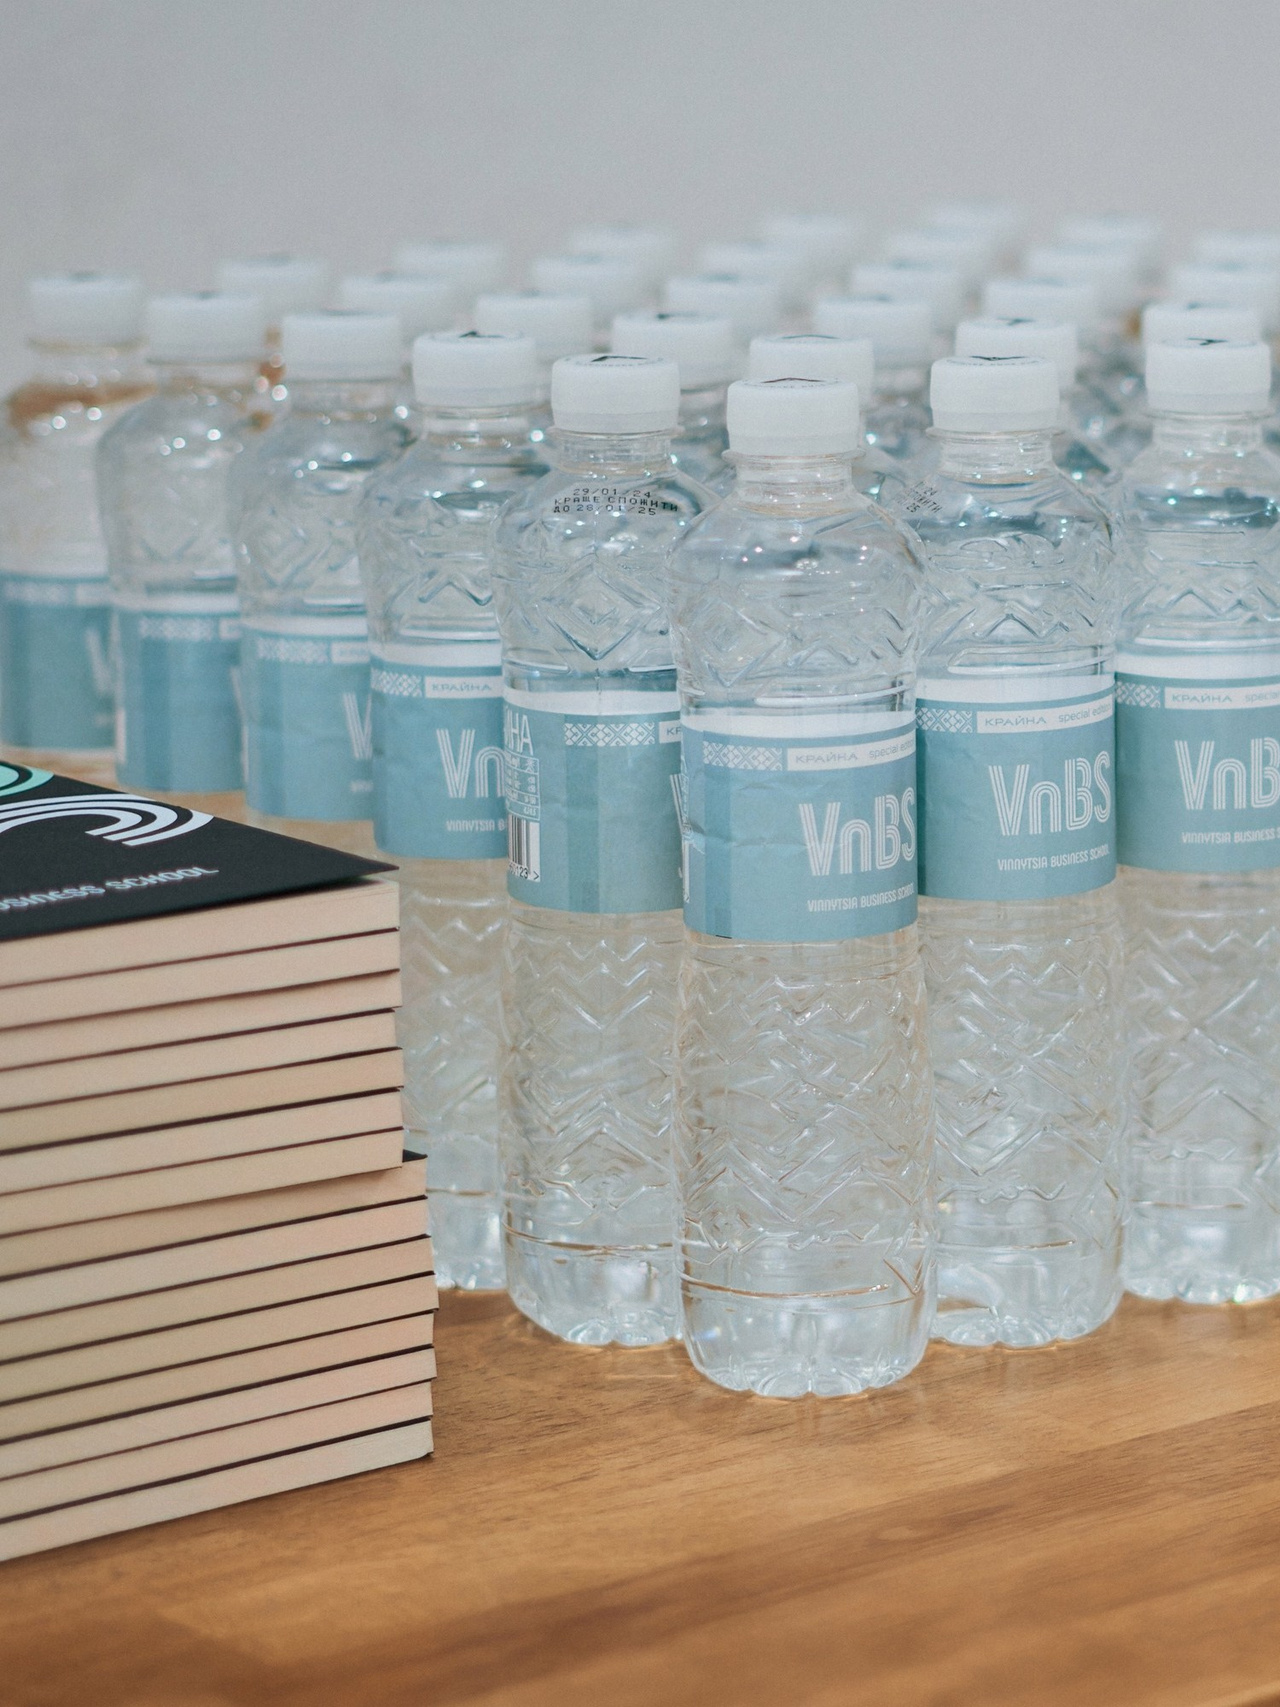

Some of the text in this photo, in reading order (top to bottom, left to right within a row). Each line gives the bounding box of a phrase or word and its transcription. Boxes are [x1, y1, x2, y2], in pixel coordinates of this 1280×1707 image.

[573, 488, 651, 498] 29/01/24
[553, 504, 656, 516] ДО 28/01/25
[607, 497, 678, 511] СПОЖИТИ
[432, 682, 492, 692] КРАЙНА
[1172, 691, 1232, 703] КРАЙНА
[985, 716, 1047, 726] КРАЙНА
[1058, 706, 1090, 723] special
[795, 752, 858, 763] КРАЙНА
[869, 743, 899, 759] special
[988, 751, 1111, 836] VnBS
[799, 787, 916, 876] VnBS
[1234, 828, 1276, 843] BUSINESS
[1050, 850, 1089, 868] BUSINESS
[105, 866, 219, 890] SCHOOL
[861, 889, 897, 909] BUSINESS
